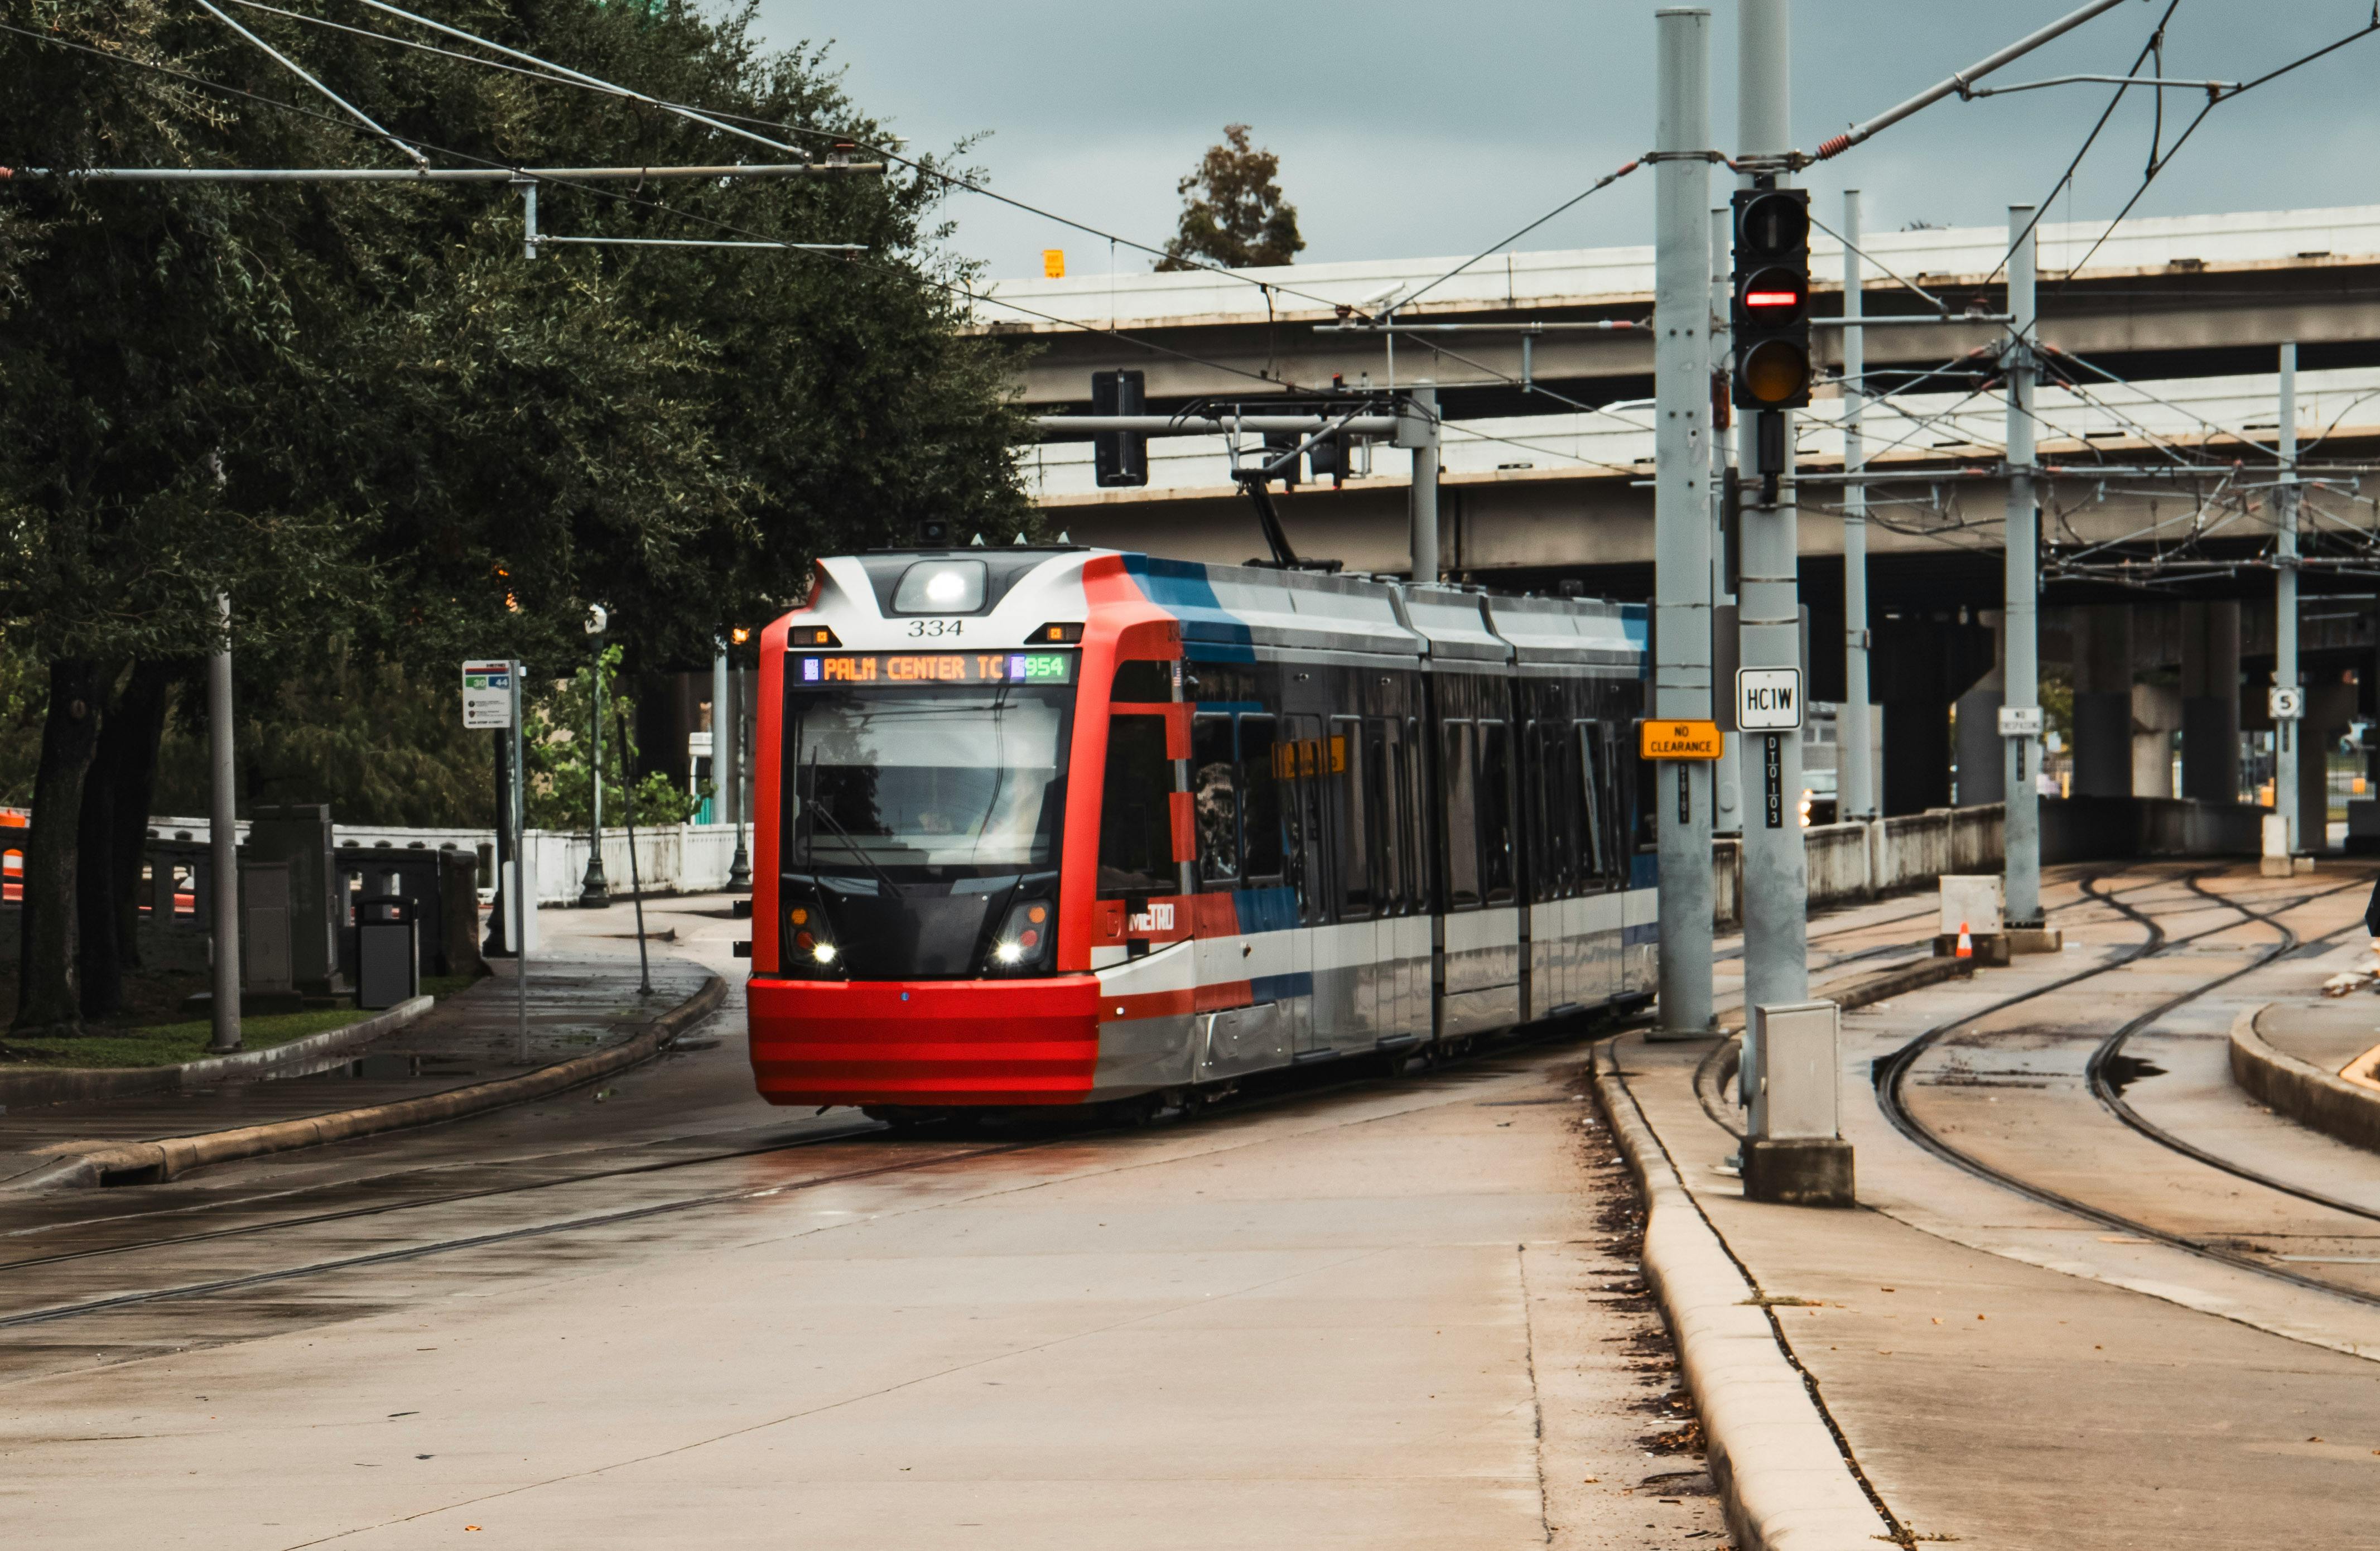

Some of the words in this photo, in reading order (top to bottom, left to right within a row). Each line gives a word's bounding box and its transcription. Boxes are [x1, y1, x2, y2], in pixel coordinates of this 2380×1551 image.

[908, 620, 963, 637] 334
[824, 657, 876, 681] PALM
[888, 655, 965, 680] CENTER
[977, 656, 1004, 679] TC
[1025, 657, 1063, 676] 954
[1748, 688, 1792, 710] HC1W
[1674, 726, 1689, 737] NO
[1651, 741, 1712, 753] CLEARANCE
